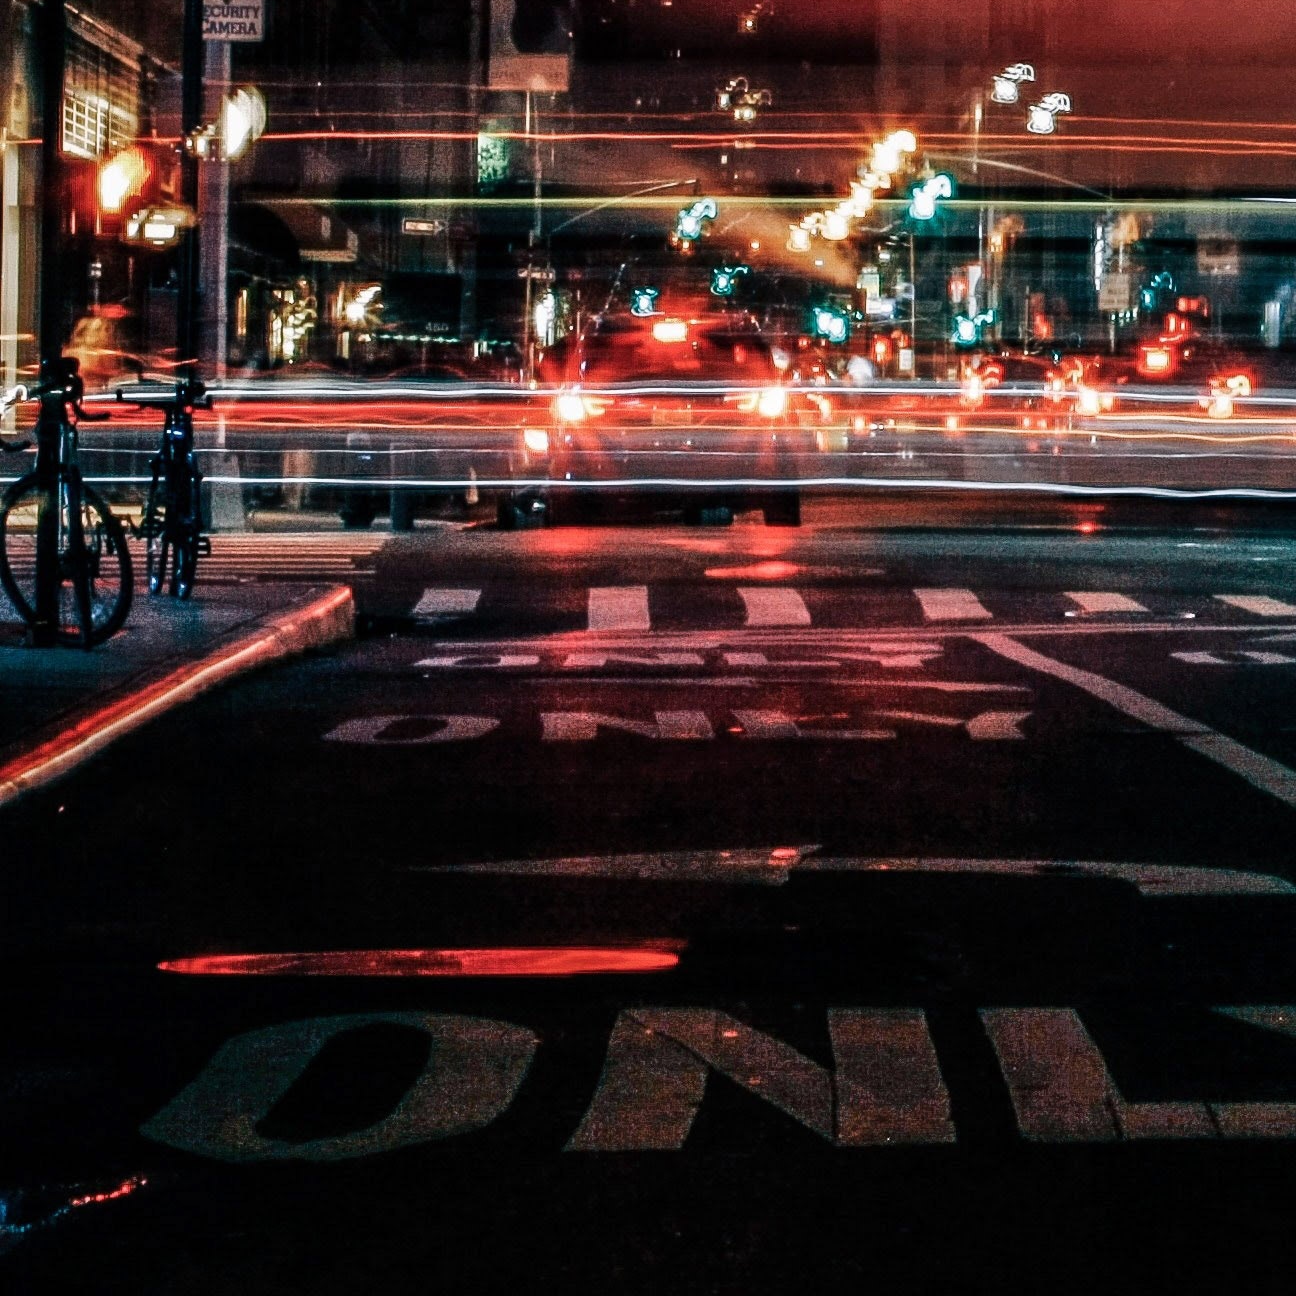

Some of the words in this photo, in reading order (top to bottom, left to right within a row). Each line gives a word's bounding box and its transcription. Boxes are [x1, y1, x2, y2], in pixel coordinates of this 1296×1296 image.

[202, 5, 261, 20] ECURITY
[202, 19, 257, 36] CAMERA
[321, 709, 1032, 744] ONLY
